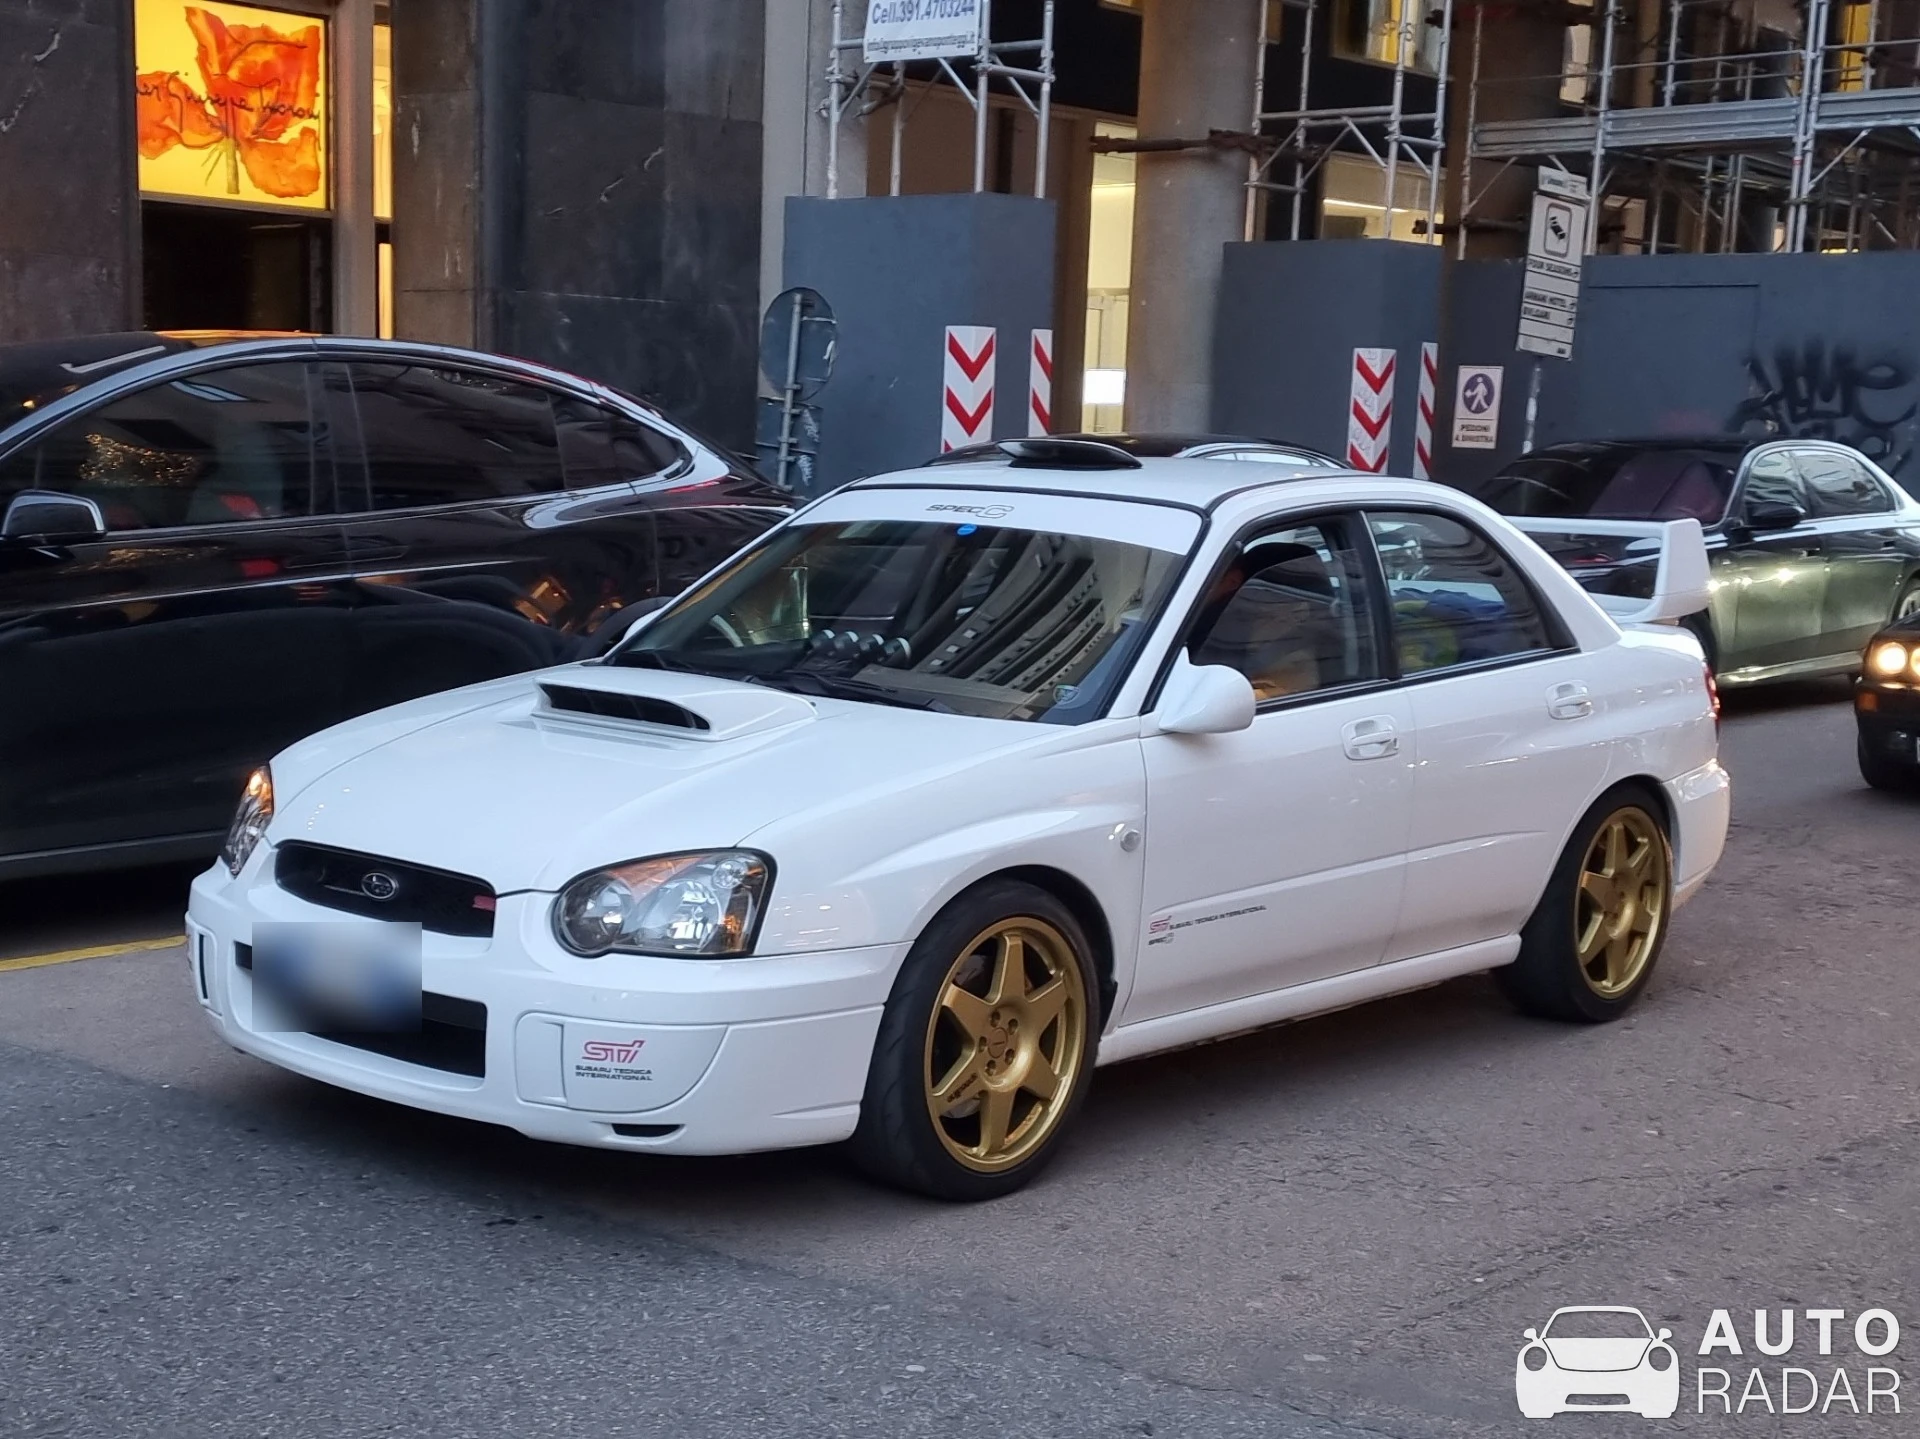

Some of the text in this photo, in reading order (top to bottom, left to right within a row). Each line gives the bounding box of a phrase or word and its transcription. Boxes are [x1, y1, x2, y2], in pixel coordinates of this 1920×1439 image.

[575, 1064, 653, 1075] SUBARU TECNICA
[575, 1071, 654, 1081] INTERNATIONAL
